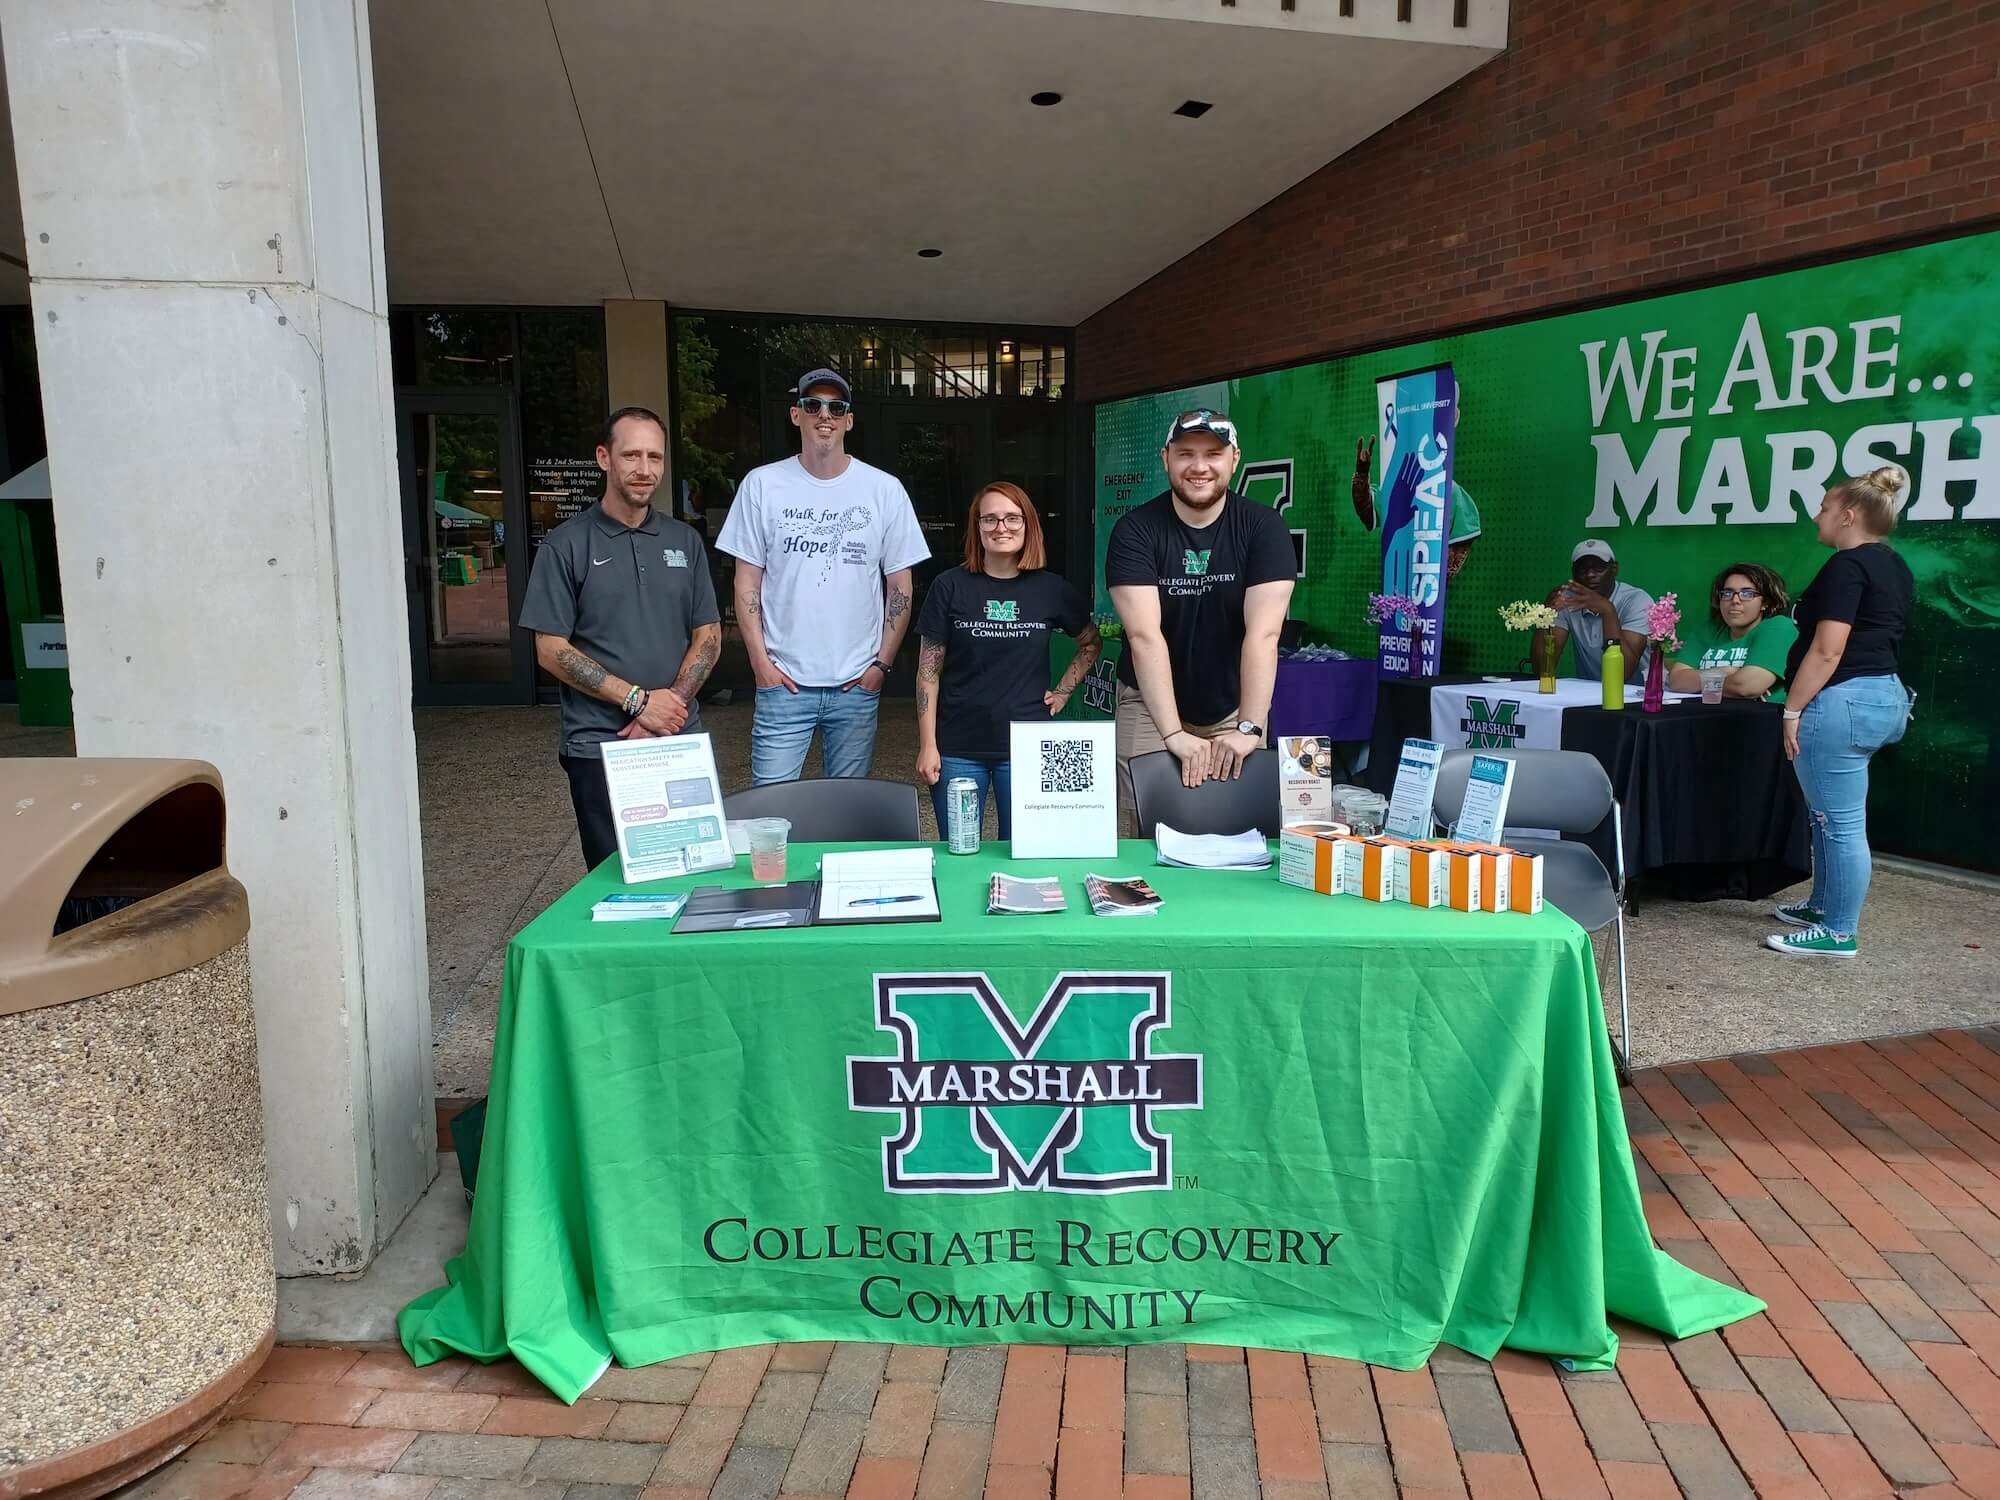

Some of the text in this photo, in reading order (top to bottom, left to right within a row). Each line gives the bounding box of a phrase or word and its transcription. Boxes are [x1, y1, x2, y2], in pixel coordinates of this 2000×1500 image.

[1579, 329, 1697, 427] WE
[534, 470, 562, 479] Monday
[580, 470, 602, 479] Friday
[1104, 472, 1145, 487] EMERGENCY
[554, 487, 584, 495] Saturday
[1117, 489, 1131, 500] EXIT
[782, 508, 839, 523] Walk for
[1411, 431, 1447, 608] SPEAC
[783, 535, 828, 558] Hope
[1168, 585, 1213, 596] COMMUTY
[954, 620, 1047, 630] COLLEGIATE RECOVER
[971, 628, 1031, 638] COMMUNITY
[1401, 616, 1436, 634] SUIDE
[1380, 635, 1435, 655] PREVENTN
[1384, 655, 1433, 676] EDUCAN
[1466, 696, 1520, 749] M
[1467, 720, 1519, 737] MARSHALL
[1024, 803, 1105, 811] Collegiate Recovery Community
[872, 970, 1172, 1194] M
[888, 1064, 1162, 1102] MARSHALL
[1175, 1174, 1198, 1190] TM
[703, 1216, 1343, 1268] COLLEGIATE RECOVERY
[859, 1274, 1207, 1331] COMMUNITY
